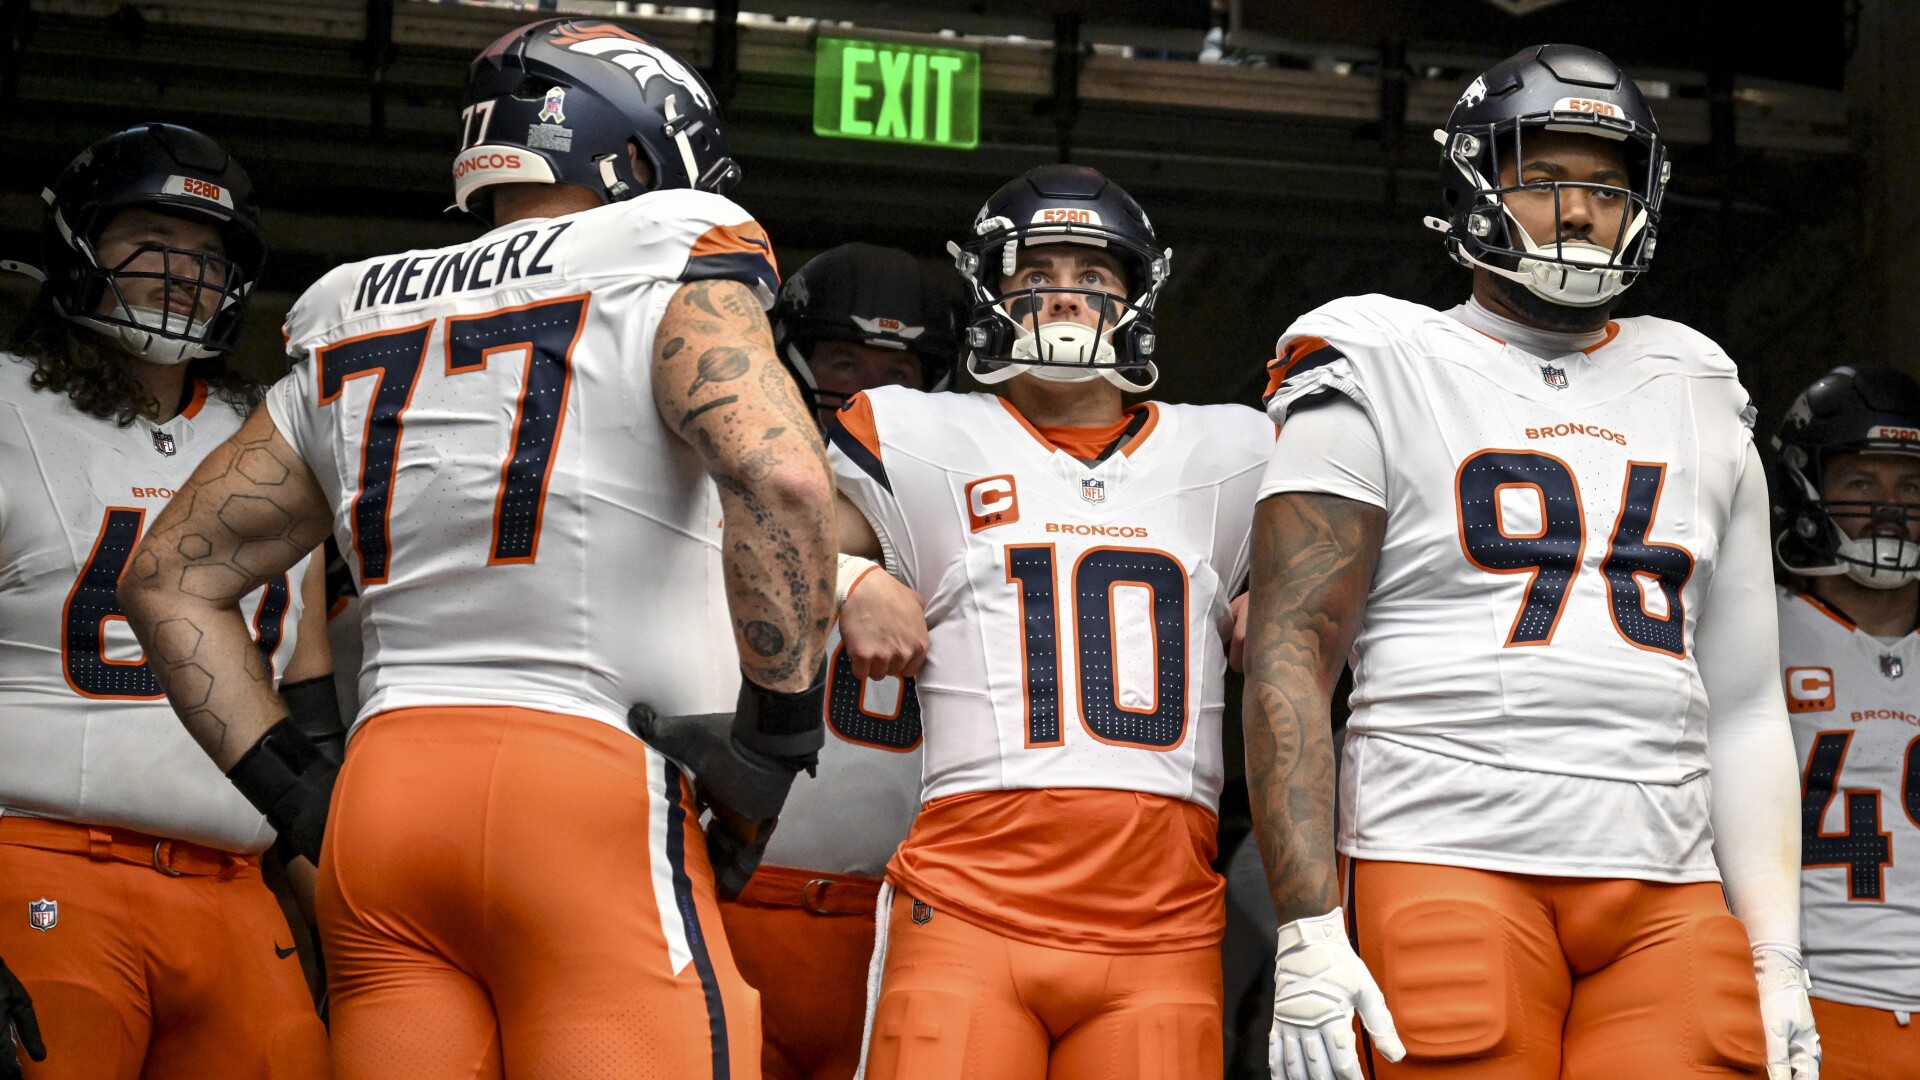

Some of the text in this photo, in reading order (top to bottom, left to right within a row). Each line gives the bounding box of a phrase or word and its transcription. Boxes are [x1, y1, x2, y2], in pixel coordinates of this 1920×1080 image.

[840, 47, 962, 143] EXIT
[460, 99, 497, 152] 77
[183, 177, 220, 201] 5280
[1044, 209, 1090, 225] 5280
[354, 221, 575, 312] MEINERZ
[316, 291, 592, 585] 77
[1525, 422, 1627, 446] BRONCOS
[970, 478, 1014, 517] C
[1045, 522, 1148, 538] BRONCOS
[1454, 447, 1695, 661] 96
[1003, 542, 1190, 753] 10
[1790, 668, 1832, 700] C
[1850, 709, 1920, 727] BRONC
[1801, 729, 1920, 902] 4
